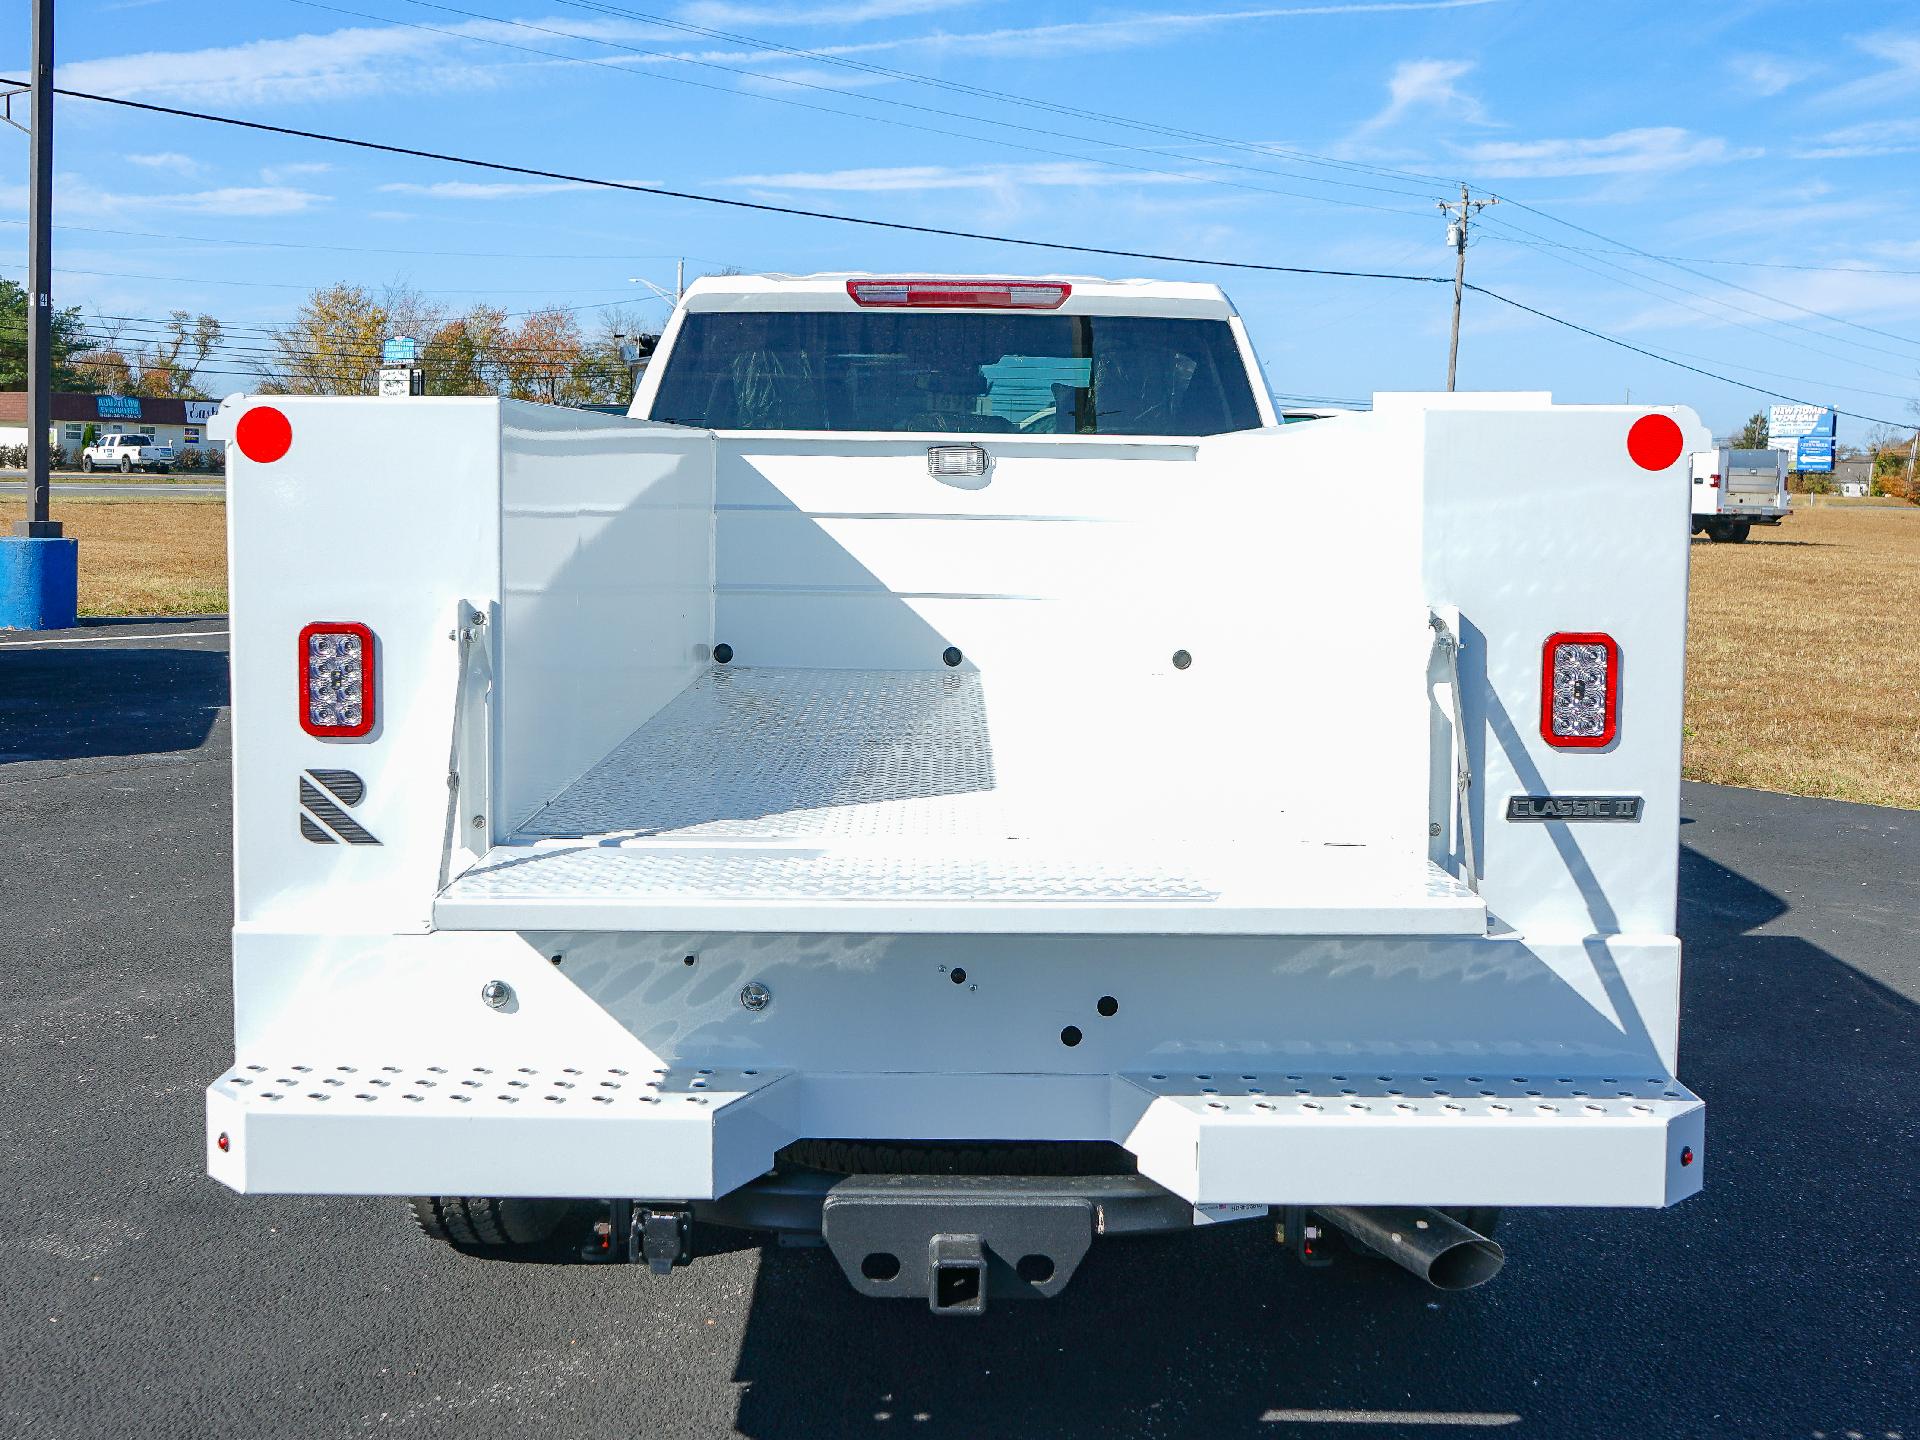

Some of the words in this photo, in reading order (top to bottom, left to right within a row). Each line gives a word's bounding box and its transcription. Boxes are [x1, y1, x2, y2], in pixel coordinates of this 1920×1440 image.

[41, 293, 47, 306] 4
[1513, 800, 1610, 816] CLASSIC
[1615, 800, 1635, 815] II
